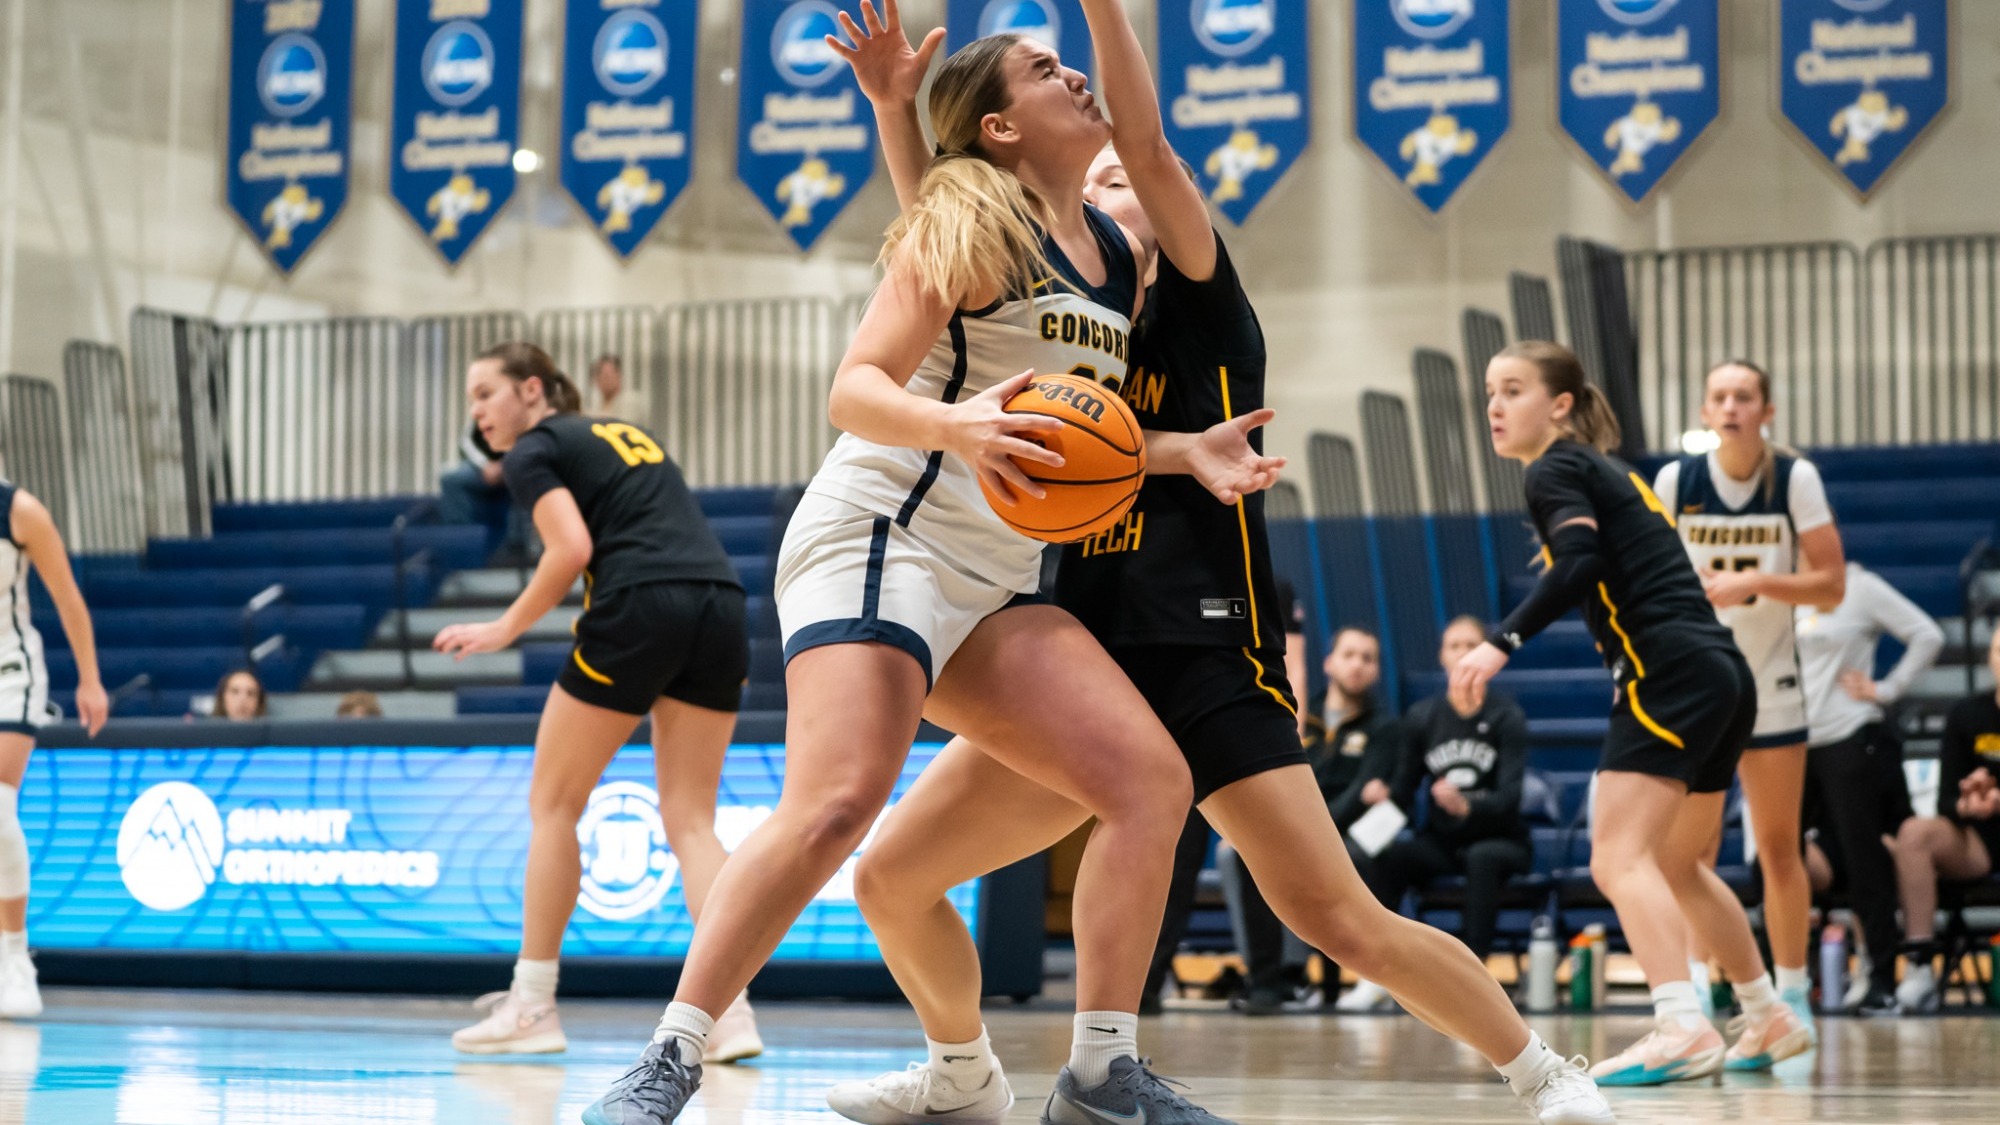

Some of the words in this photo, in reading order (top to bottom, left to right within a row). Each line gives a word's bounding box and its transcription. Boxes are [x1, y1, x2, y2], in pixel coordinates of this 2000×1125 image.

[1016, 382, 1106, 424] Wilso
[1122, 366, 1167, 414] AN
[591, 423, 664, 467] 13
[1234, 604, 1241, 613] L
[227, 807, 351, 843] SUMMIT
[223, 849, 439, 887] ORTHOPEDICS
